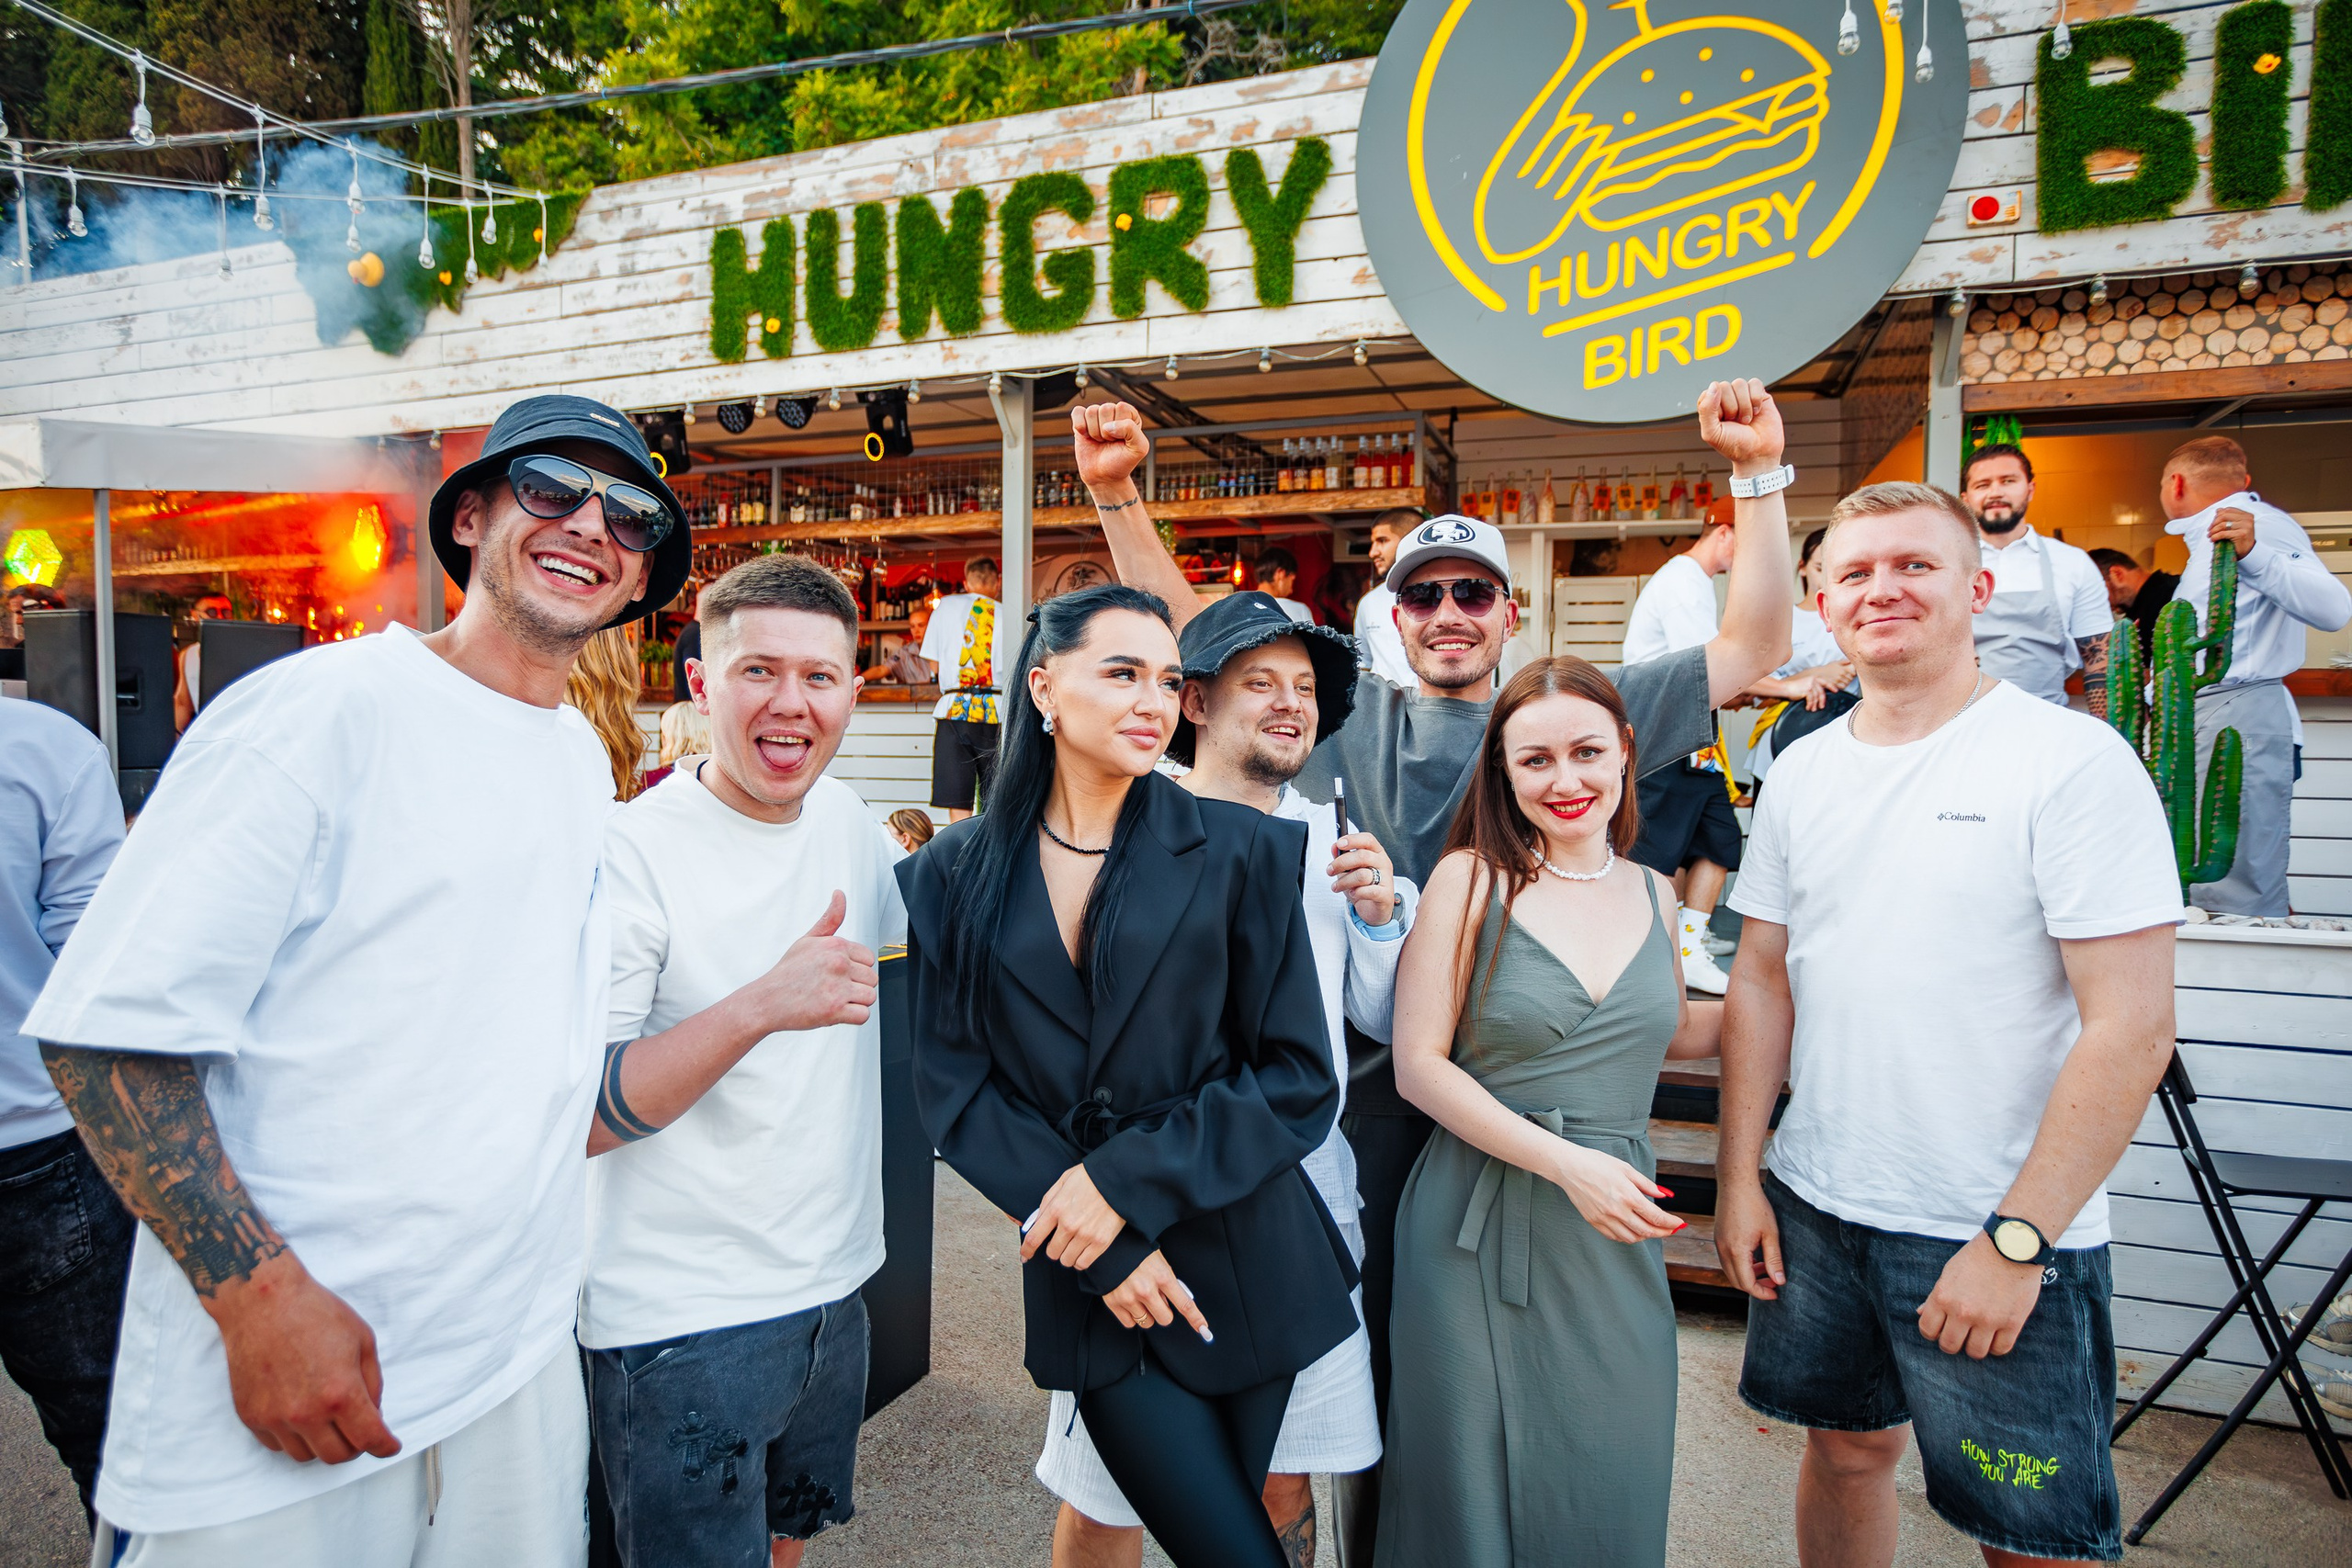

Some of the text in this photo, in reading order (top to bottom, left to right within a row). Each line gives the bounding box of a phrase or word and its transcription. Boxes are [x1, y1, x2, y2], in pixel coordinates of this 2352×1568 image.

[710, 135, 1332, 363] HUNGRY
[1527, 179, 1817, 315] HUNGRY
[1583, 303, 1743, 390] BIRD
[1944, 811, 1986, 823] Columbia
[1961, 1438, 2062, 1475] HOW STRONG
[1979, 1462, 2044, 1489] YOU ARE
